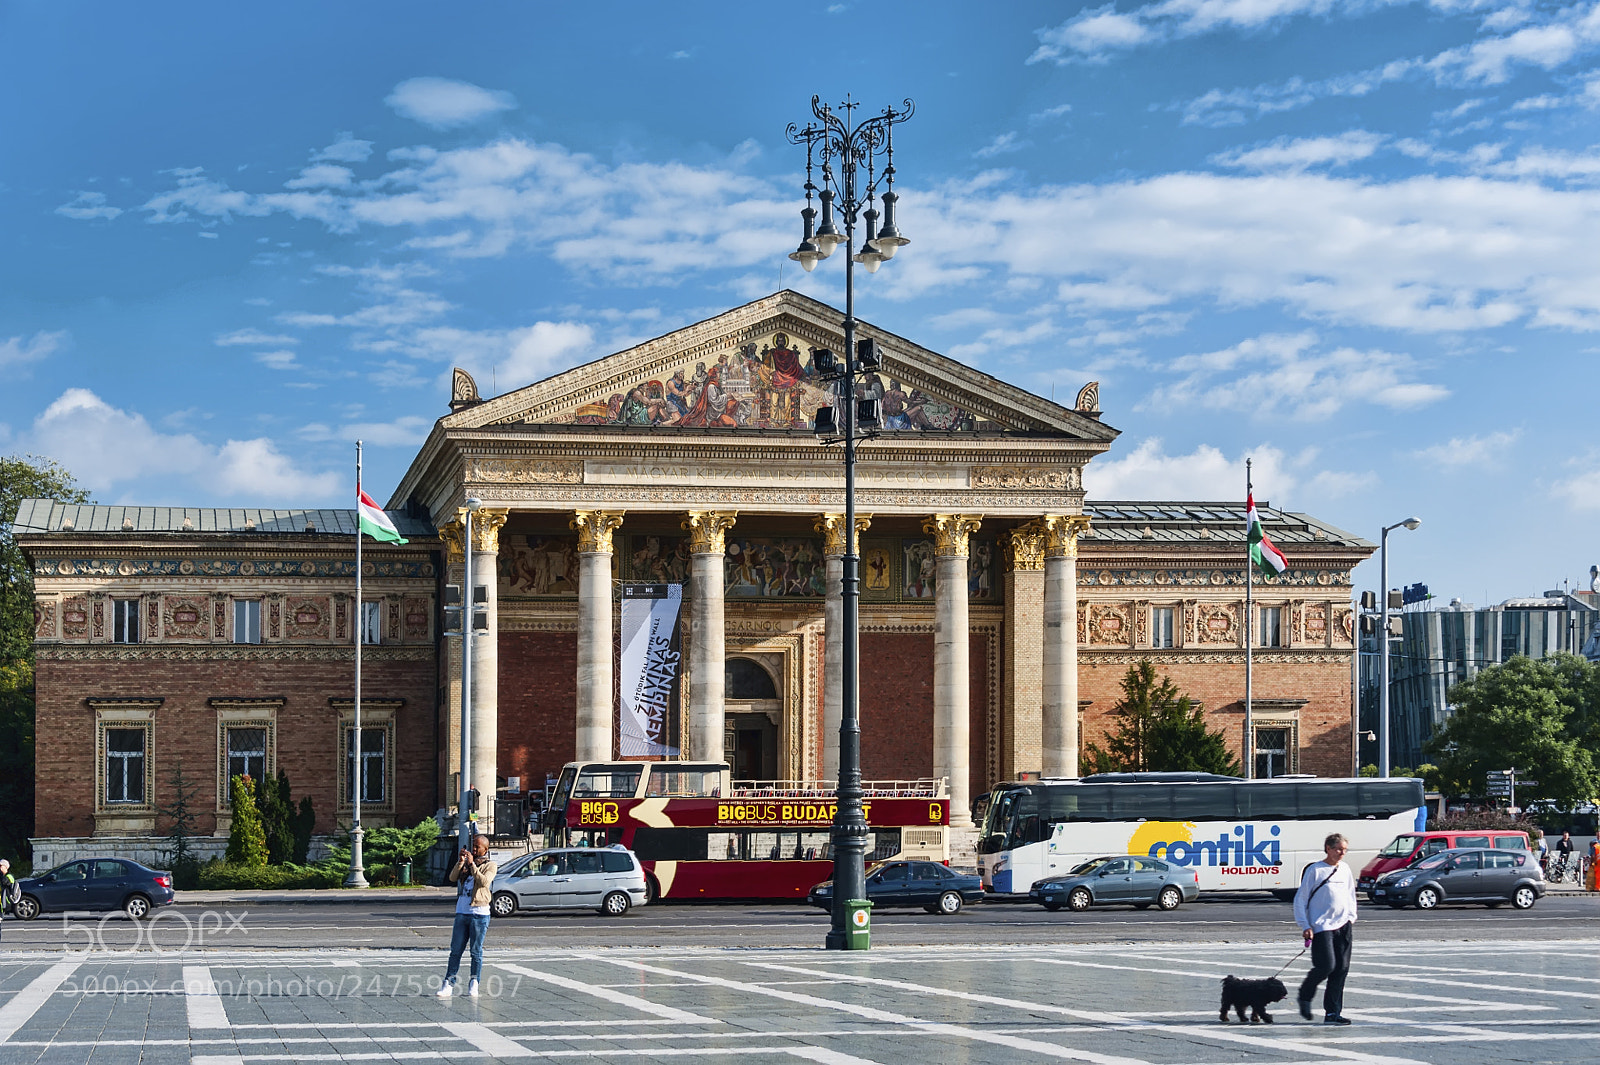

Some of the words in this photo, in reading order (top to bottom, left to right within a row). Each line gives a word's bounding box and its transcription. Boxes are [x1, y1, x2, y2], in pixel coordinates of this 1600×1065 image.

[627, 467, 688, 479] MAGYAR
[651, 617, 661, 635] WALL
[646, 650, 680, 746] KEMPINAS
[581, 801, 602, 814] BIG
[782, 805, 872, 820] BUDAPT
[581, 814, 602, 824] BUS
[1148, 824, 1281, 867] contiki
[1221, 866, 1279, 875] HOLIDAYS
